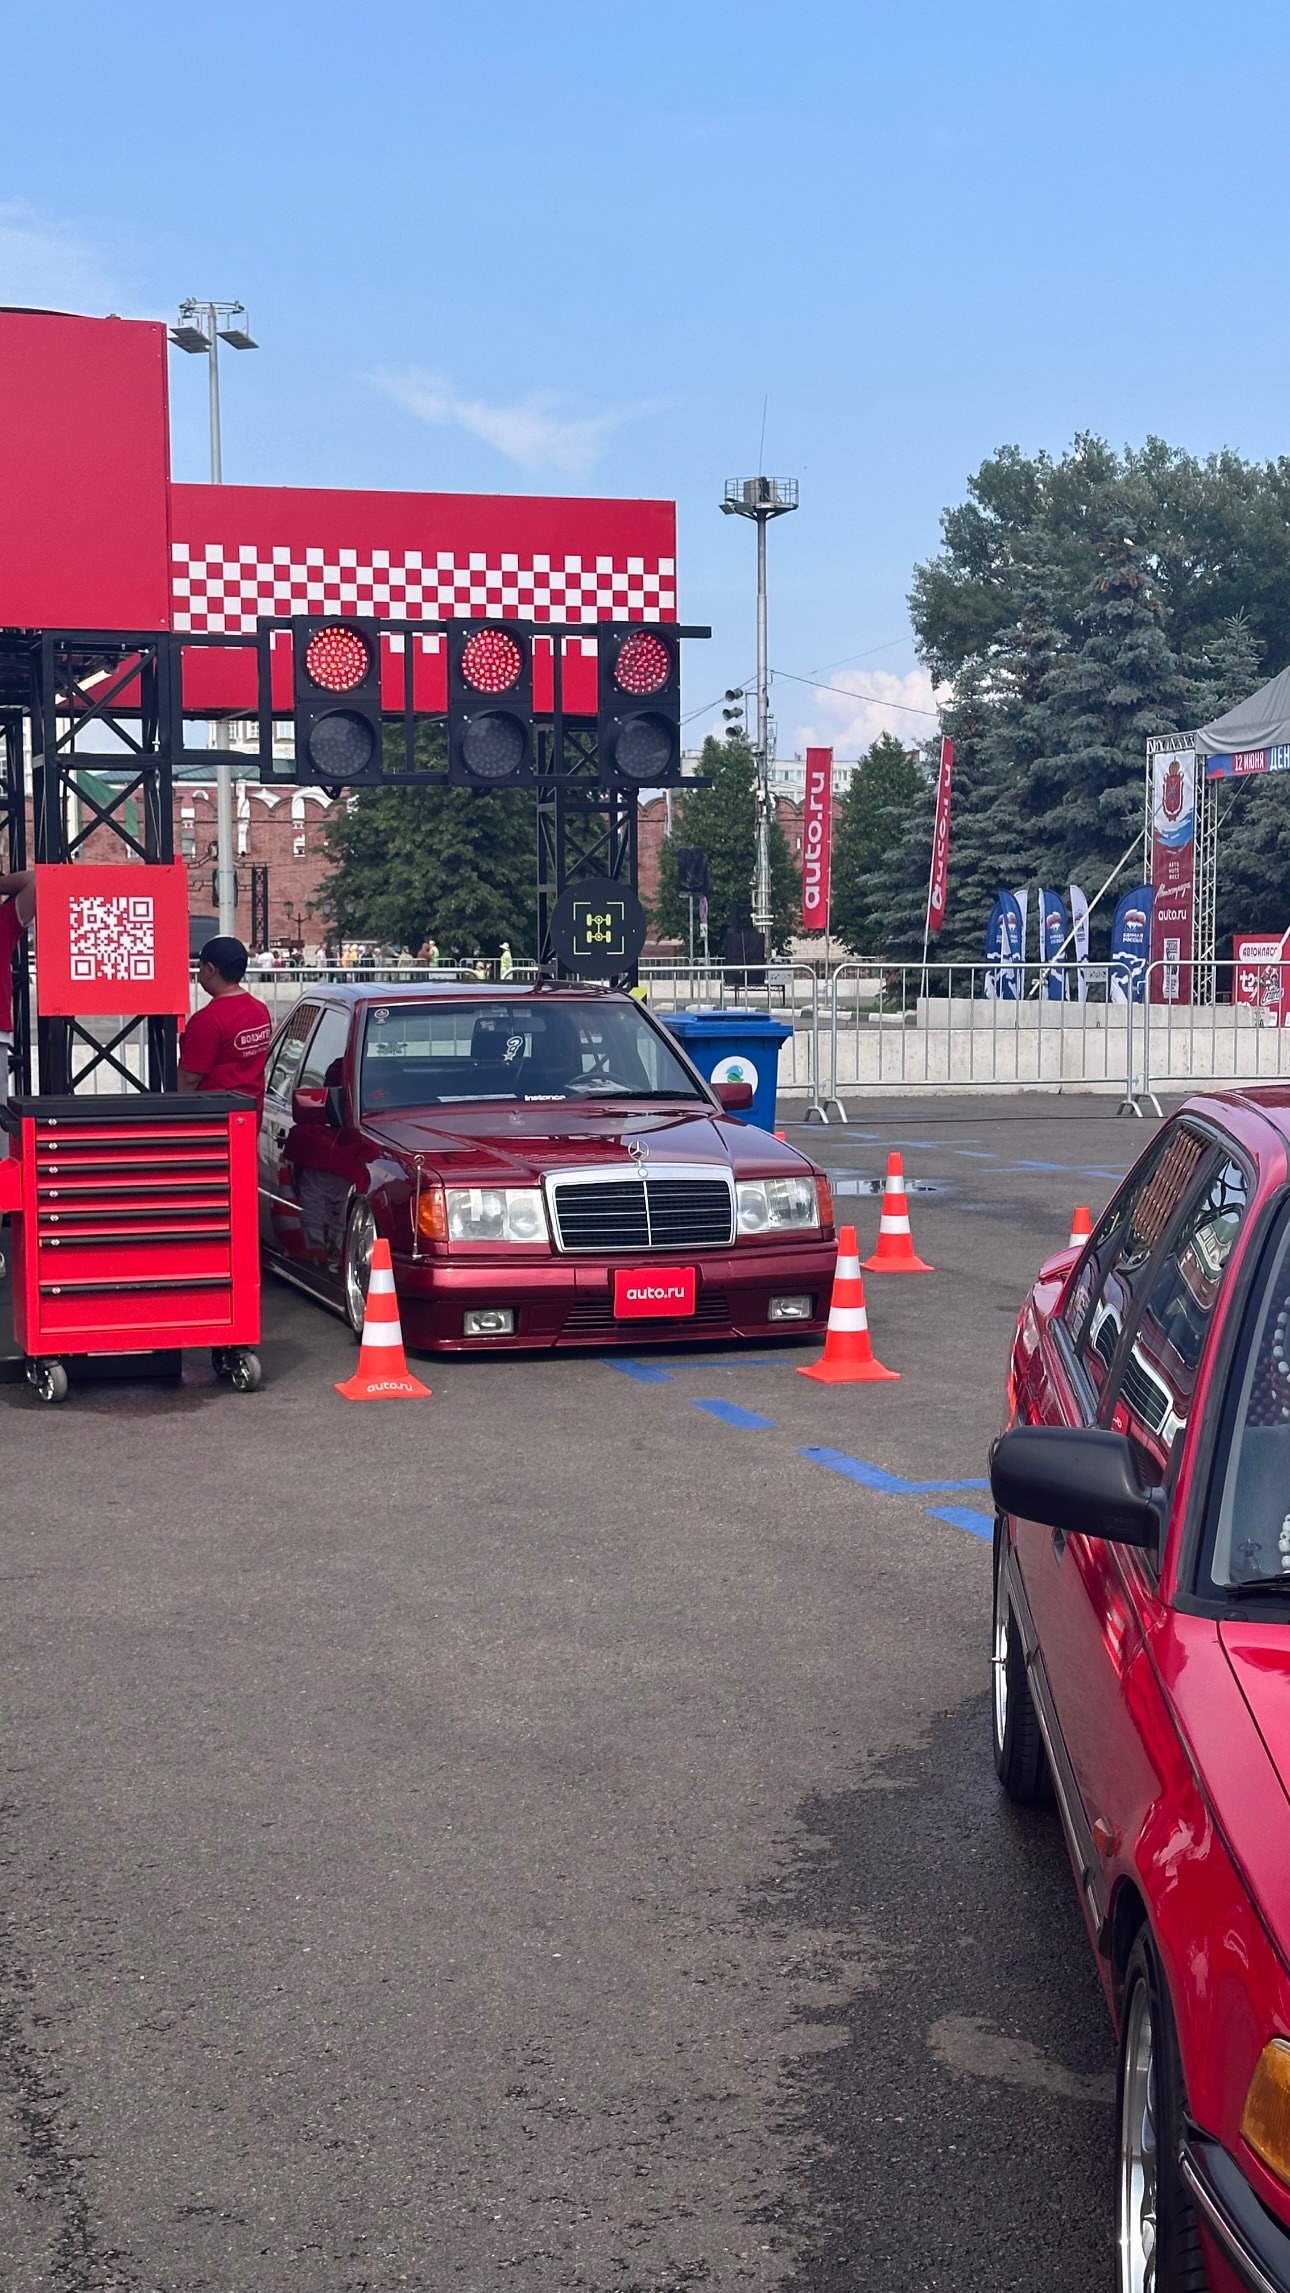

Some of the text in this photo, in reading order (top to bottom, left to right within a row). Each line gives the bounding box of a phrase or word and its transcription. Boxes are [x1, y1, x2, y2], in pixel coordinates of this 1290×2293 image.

[1235, 755, 1243, 771] 12
[1244, 752, 1264, 770] ИЮНЯ
[805, 772, 825, 909] auto.ru
[1158, 908, 1187, 921] auto.ru
[626, 1286, 685, 1300] auto.ru
[366, 1381, 413, 1393] auto.ru
